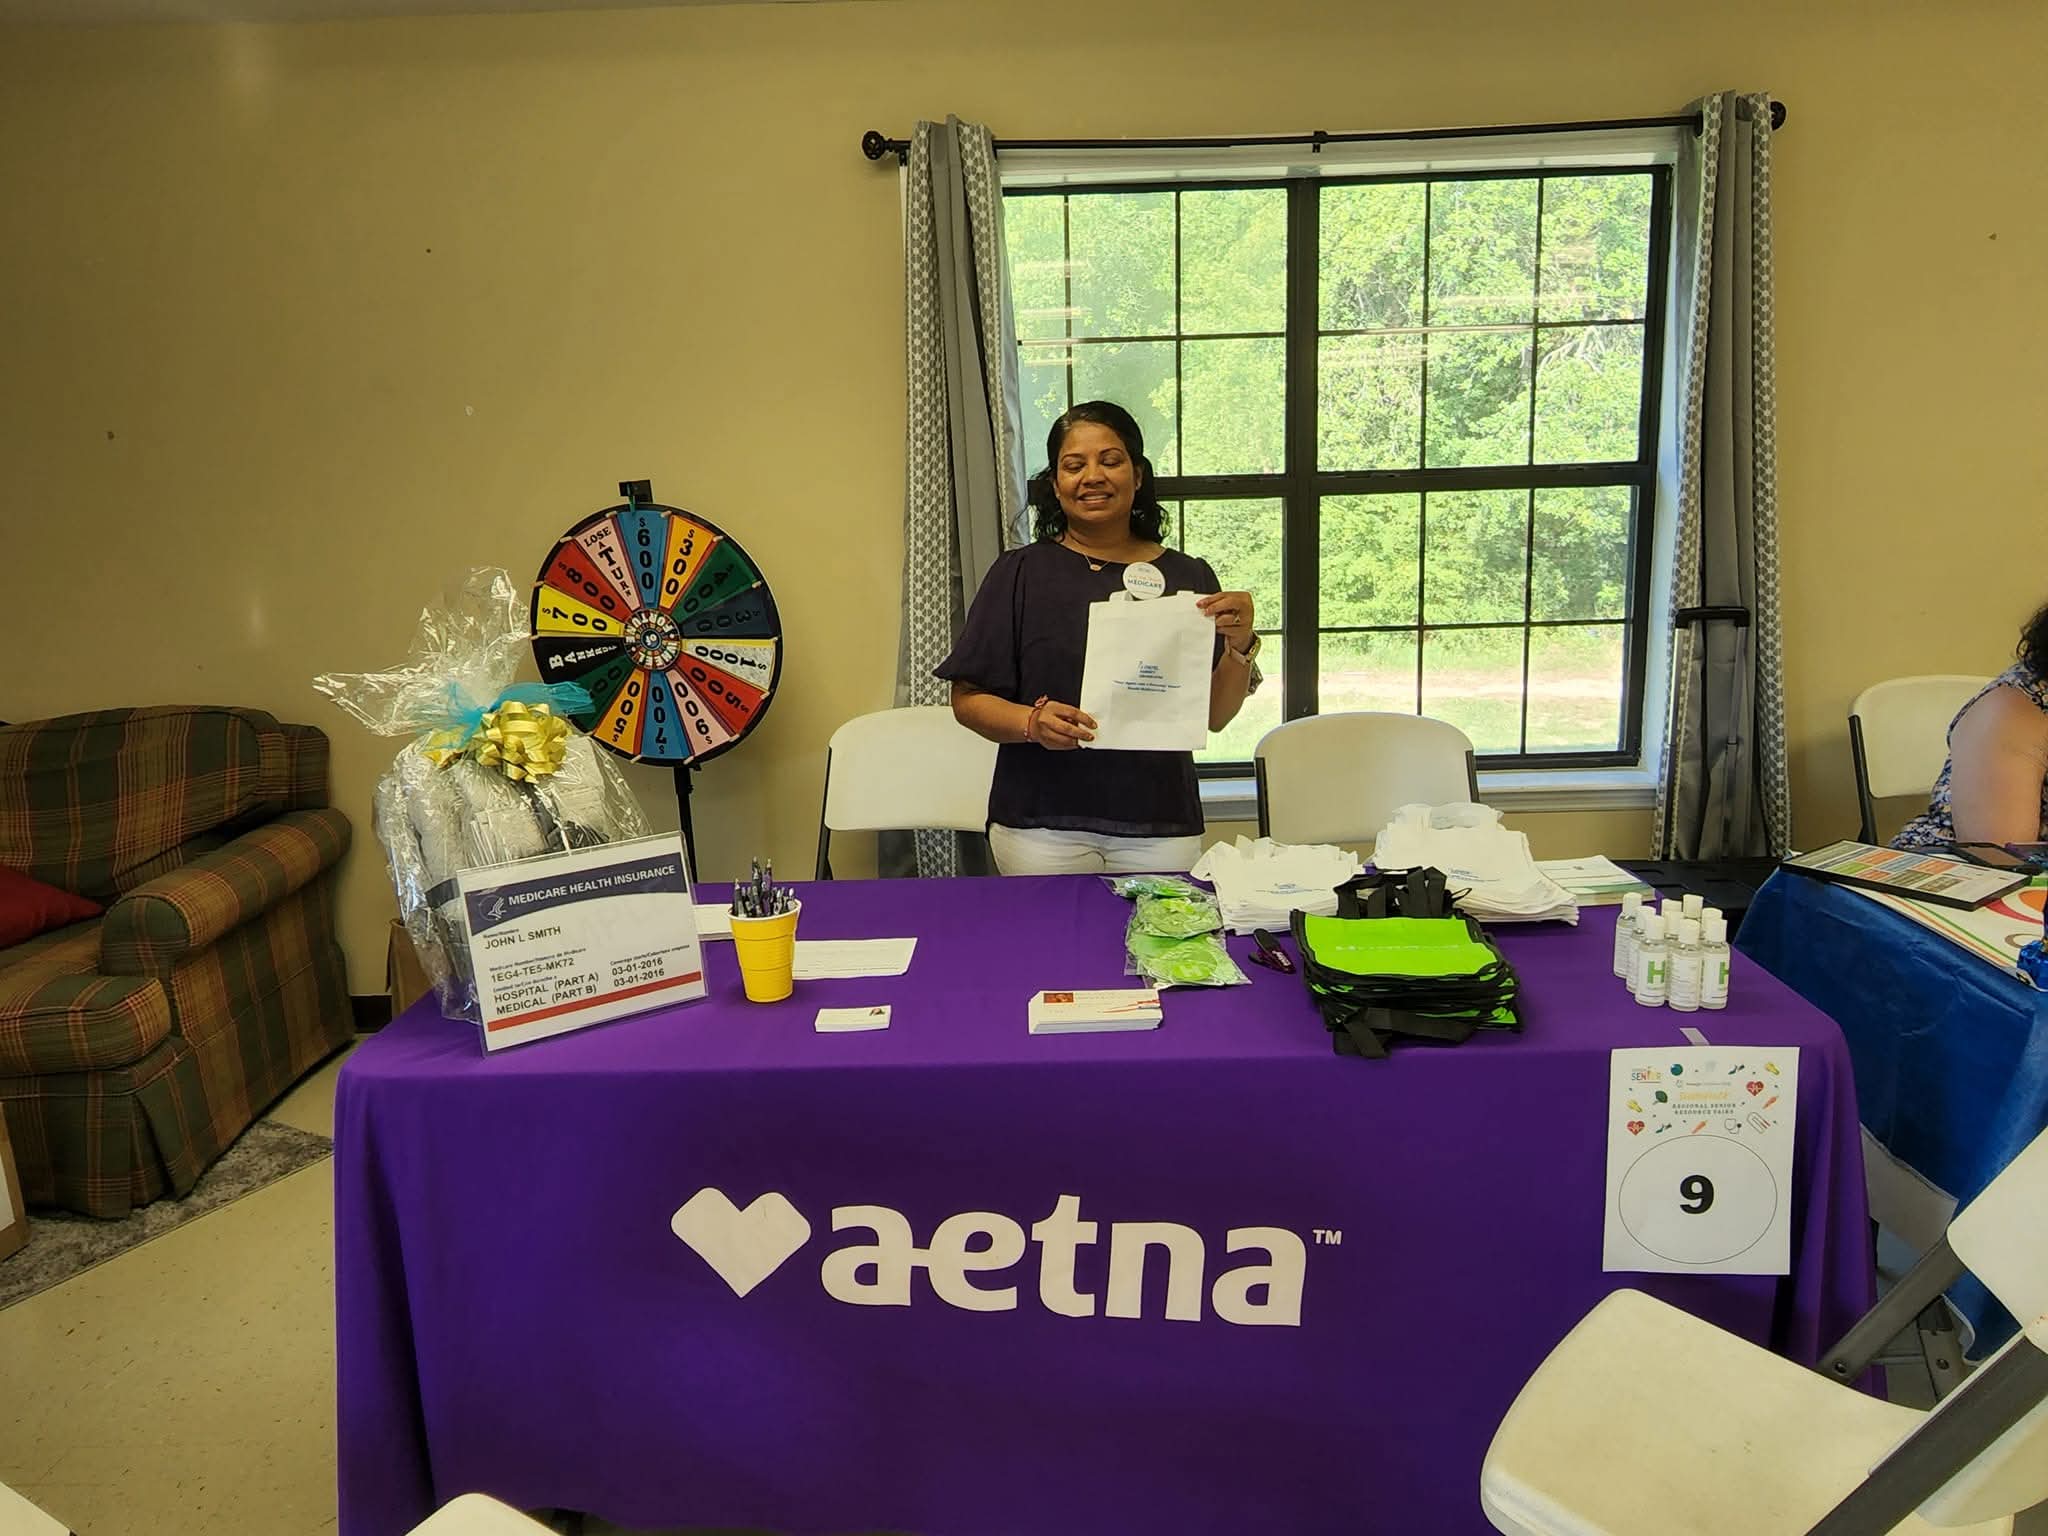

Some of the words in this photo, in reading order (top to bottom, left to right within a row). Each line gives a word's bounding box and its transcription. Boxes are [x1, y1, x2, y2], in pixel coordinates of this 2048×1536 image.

[584, 526, 612, 547] LOSE
[598, 541, 606, 550] A
[598, 546, 632, 597] TURN
[508, 886, 568, 906] MEDICARE
[569, 877, 612, 894] HEALTH
[614, 865, 677, 885] INSURANCE
[484, 935, 516, 950] JOHN
[519, 934, 525, 942] L
[527, 926, 562, 941] SMITH
[491, 957, 575, 983] 1EG4-TE5-MK72
[612, 957, 663, 976] 03-01-2016
[613, 968, 665, 987] 03-01-2016
[494, 984, 549, 1003] HOSPITAL
[554, 974, 585, 991] (PART
[588, 971, 599, 982] A)
[496, 996, 546, 1015] MEDICAL
[551, 987, 583, 1004] (PART
[585, 983, 597, 995] B)
[1679, 1174, 1714, 1214] 9
[820, 1194, 1307, 1326] aetna
